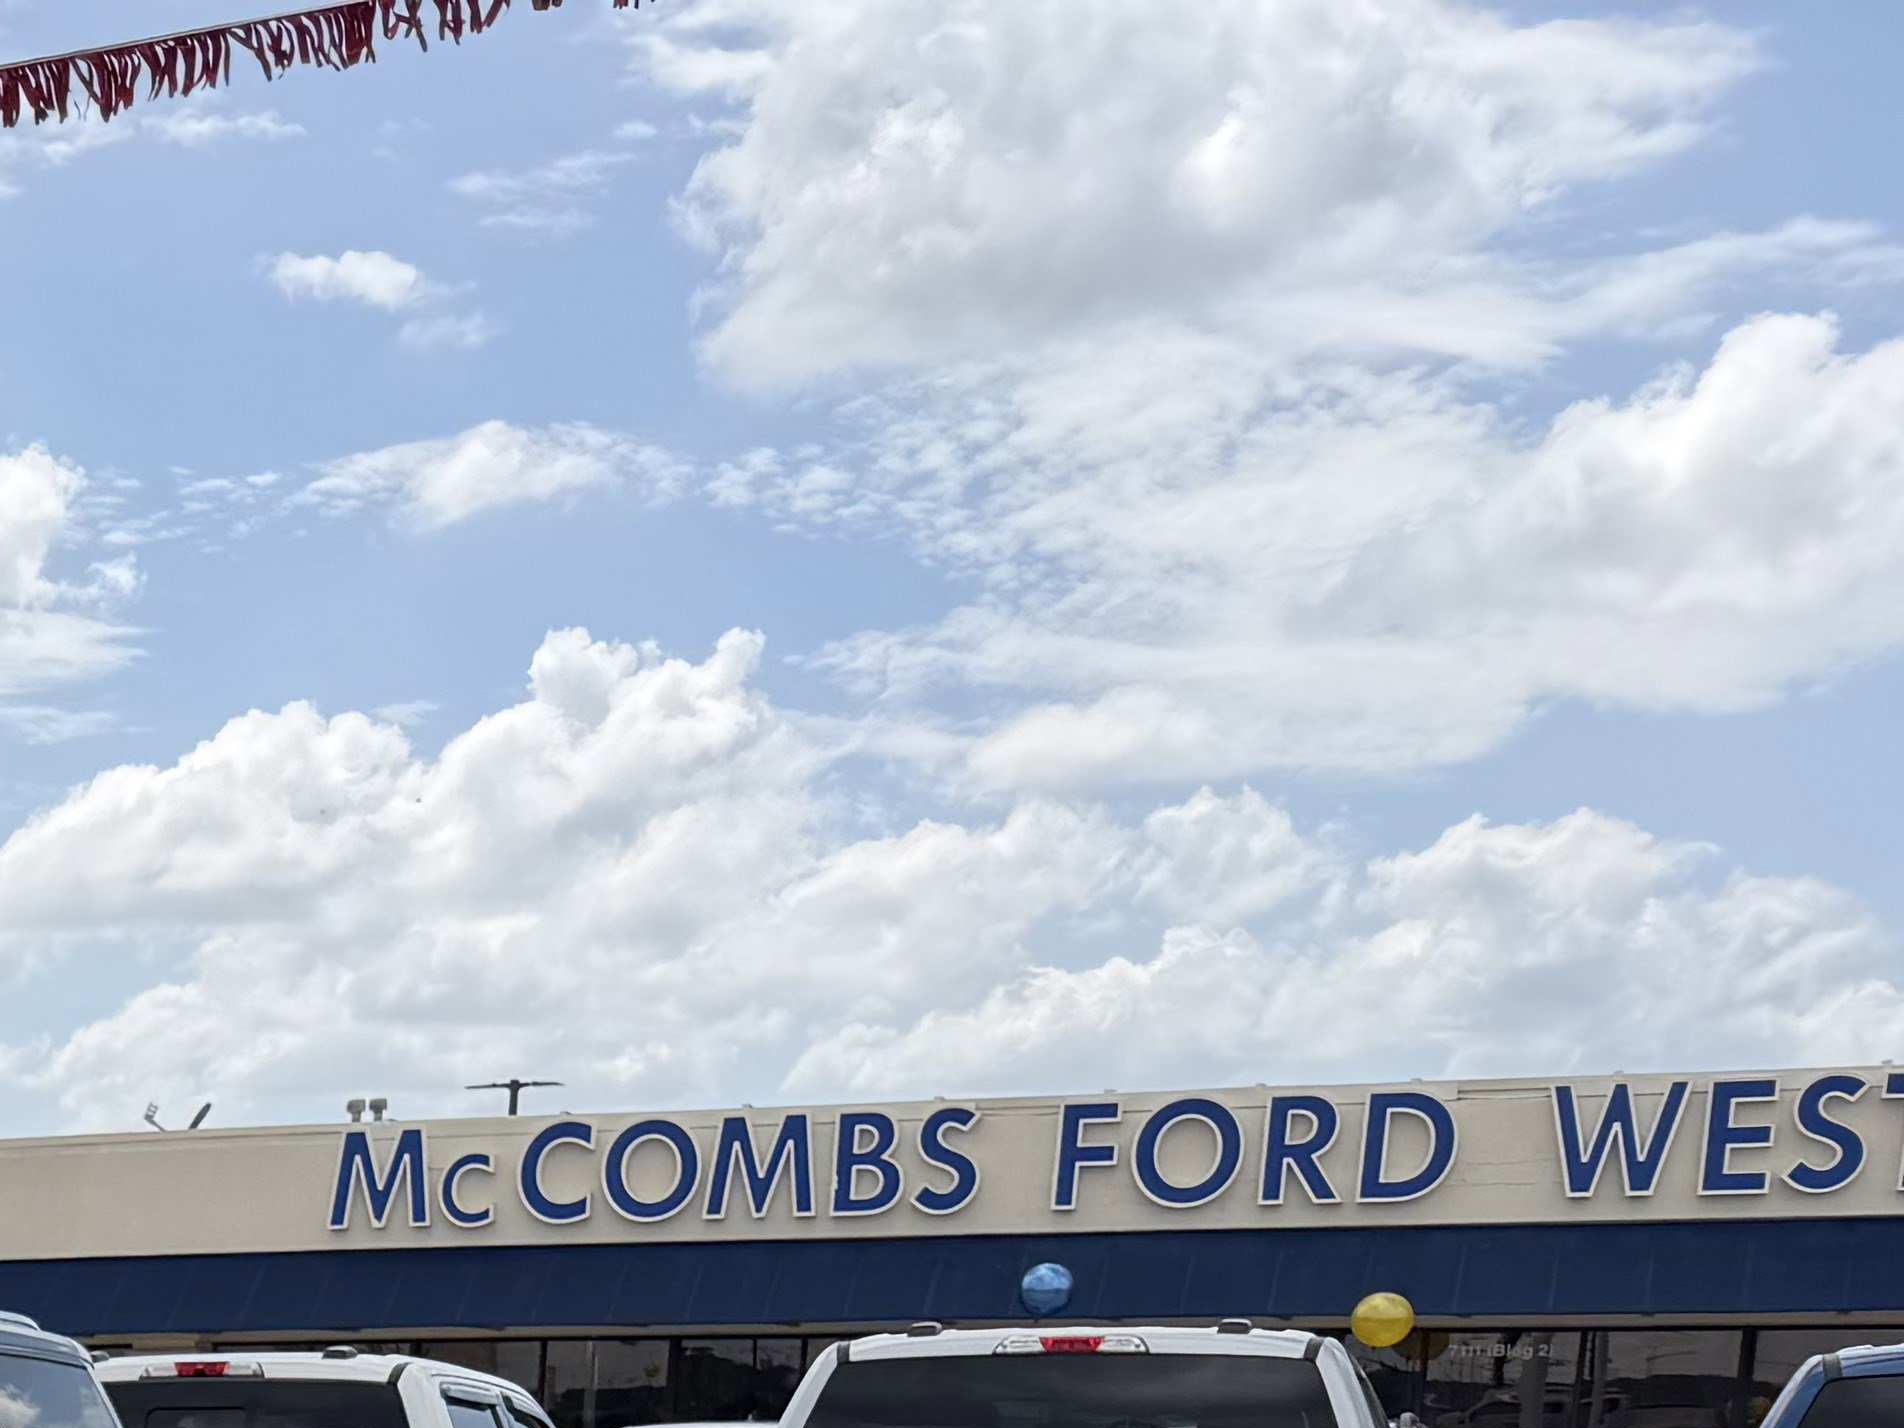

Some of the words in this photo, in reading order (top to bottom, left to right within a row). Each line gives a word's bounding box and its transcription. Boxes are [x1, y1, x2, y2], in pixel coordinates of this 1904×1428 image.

[327, 1107, 982, 1230] McCOMBS
[1050, 1090, 1459, 1212] FORD
[1551, 1073, 1904, 1199] WES
